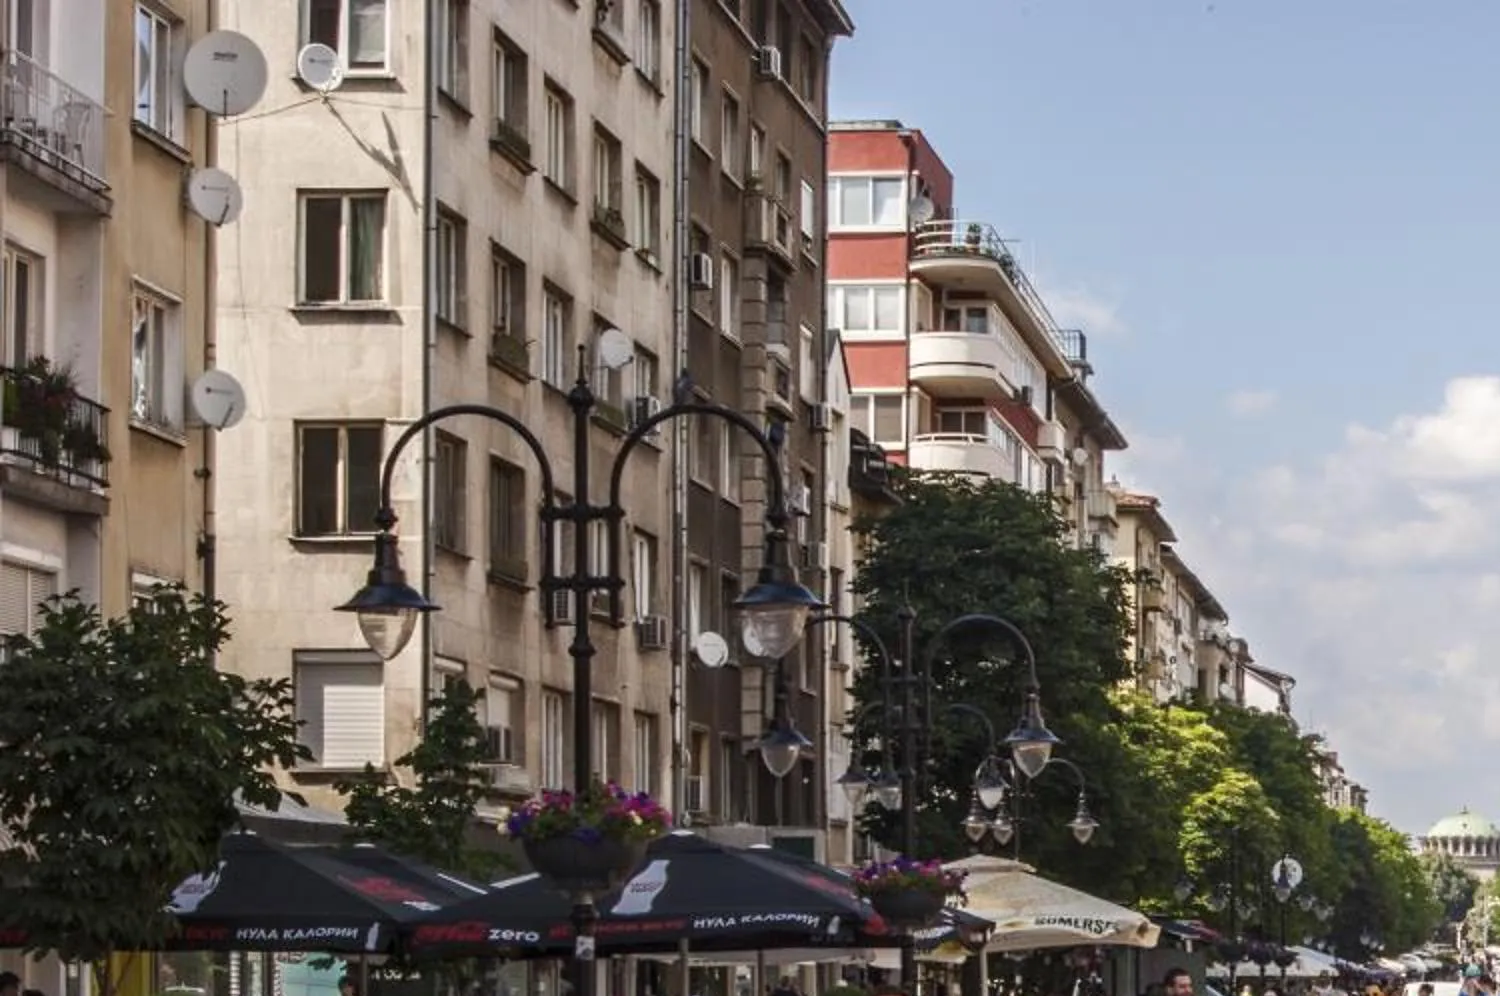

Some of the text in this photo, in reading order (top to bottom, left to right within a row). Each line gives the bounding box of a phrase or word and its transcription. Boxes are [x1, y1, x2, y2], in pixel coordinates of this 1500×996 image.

[692, 911, 821, 930] НУЛА КАЛОРИИ
[236, 927, 279, 941] НУЛА
[283, 926, 359, 941] КАЛОРИИ
[487, 927, 540, 943] zero
